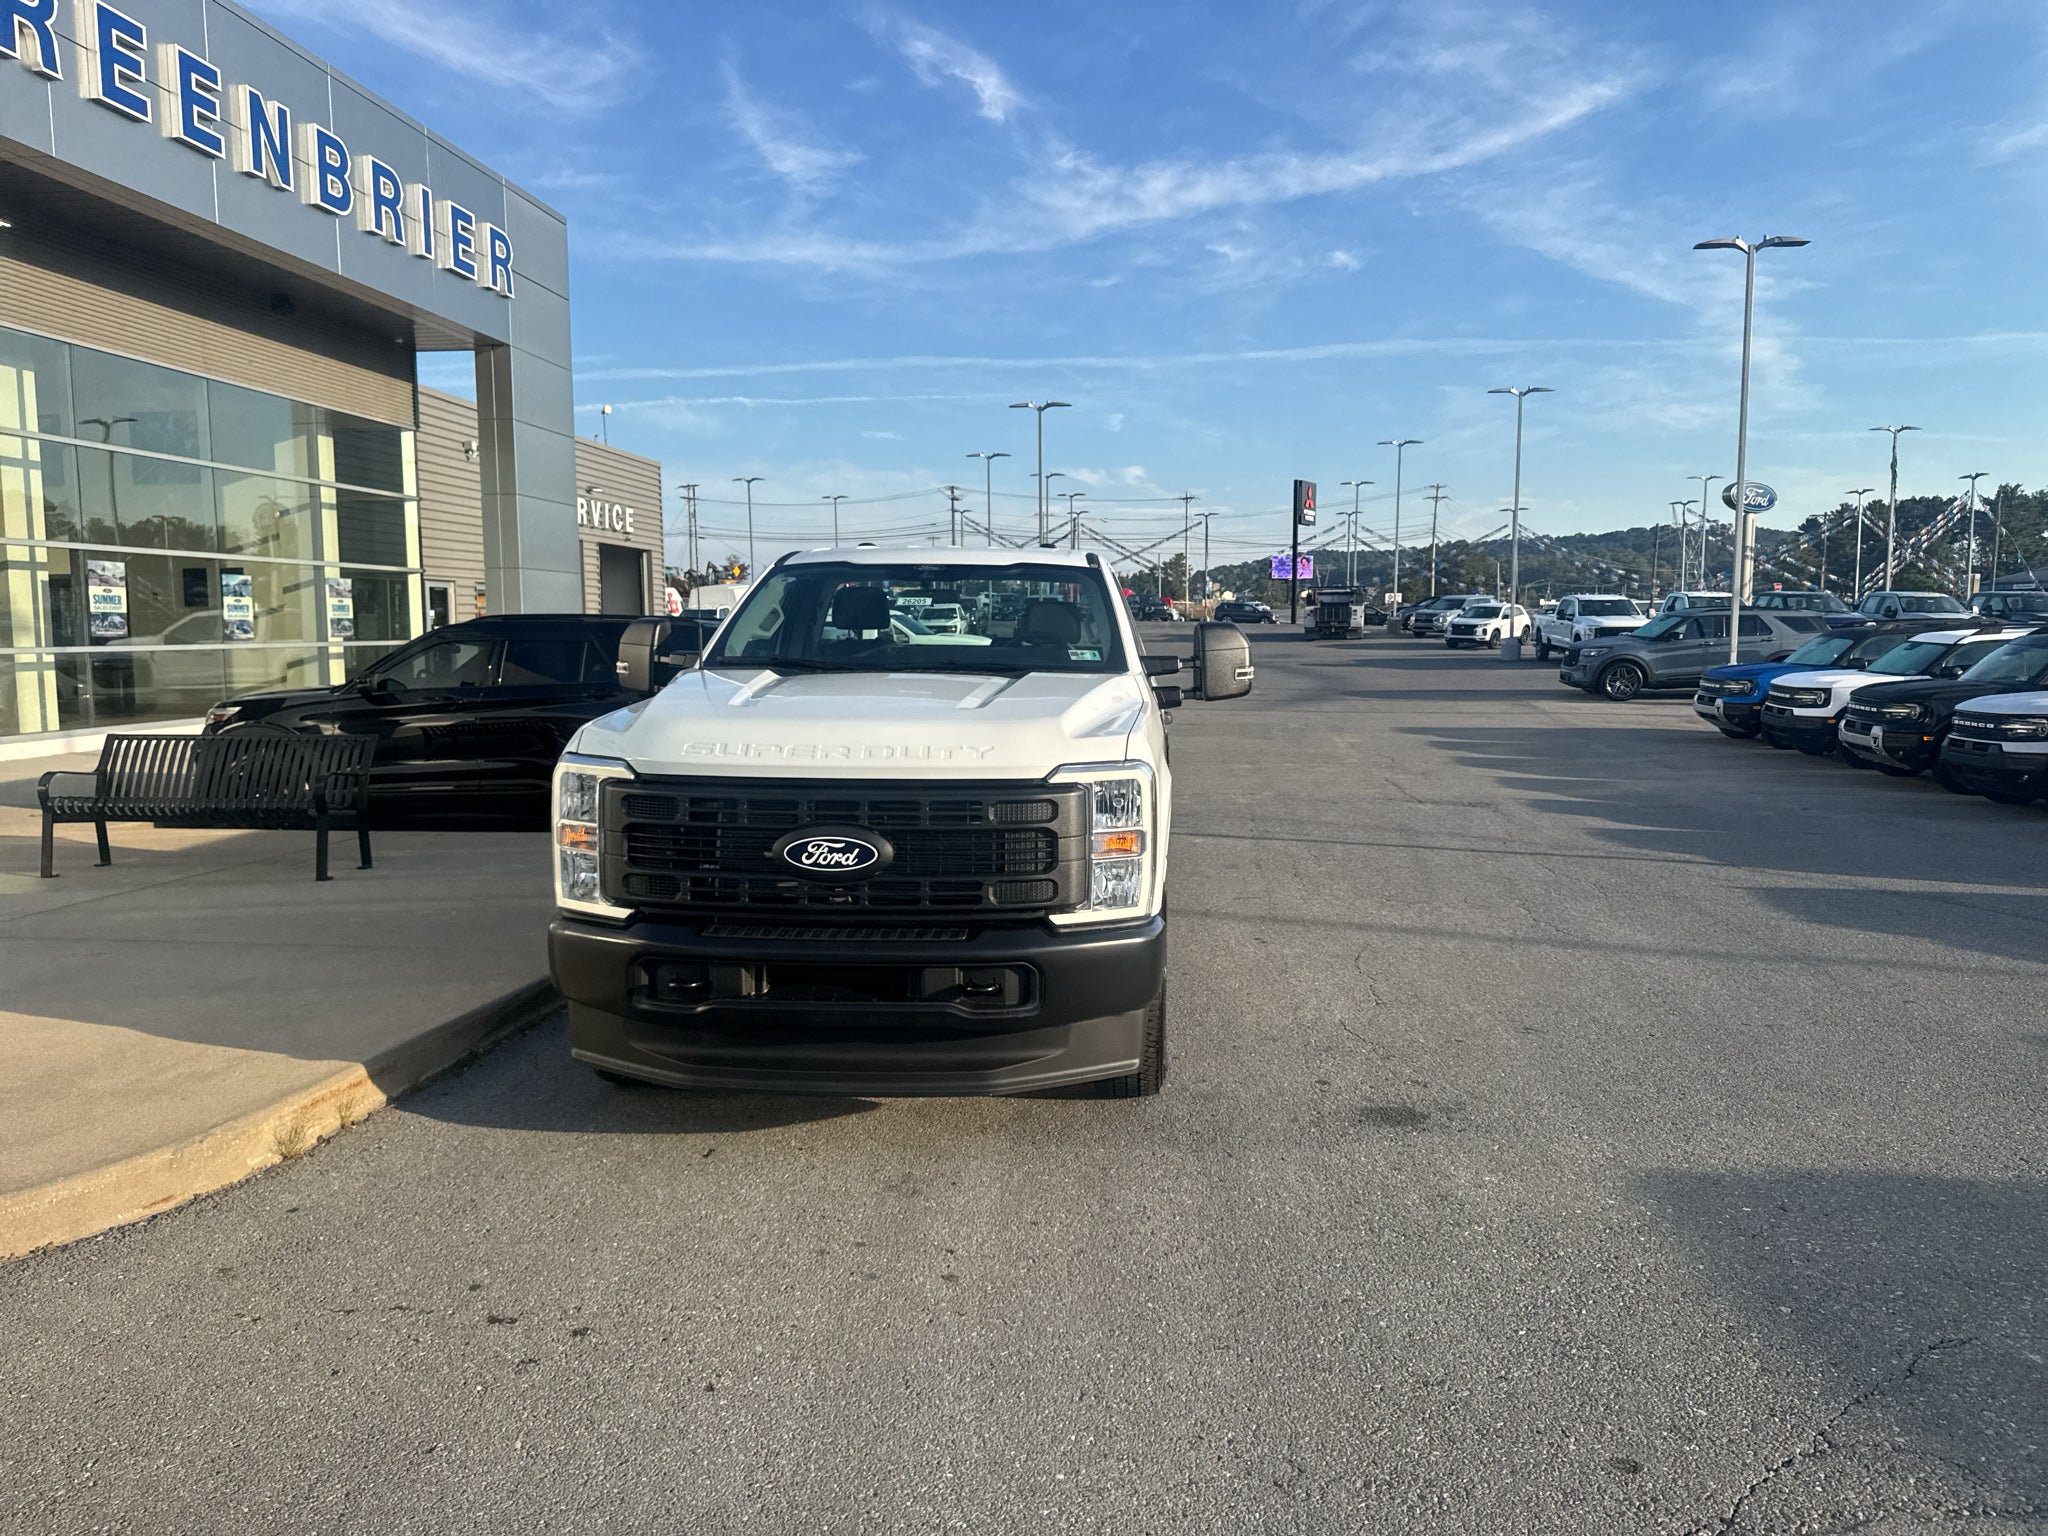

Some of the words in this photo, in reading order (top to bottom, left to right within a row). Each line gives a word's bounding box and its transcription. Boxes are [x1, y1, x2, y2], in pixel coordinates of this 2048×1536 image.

[1743, 487, 1771, 507] Ford
[577, 497, 635, 533] RVICE
[92, 593, 123, 605] SUMMER
[1952, 718, 1996, 729] BRONCO
[681, 742, 850, 759] SUPER
[860, 744, 995, 760] DUTY
[801, 841, 860, 866] Ford
